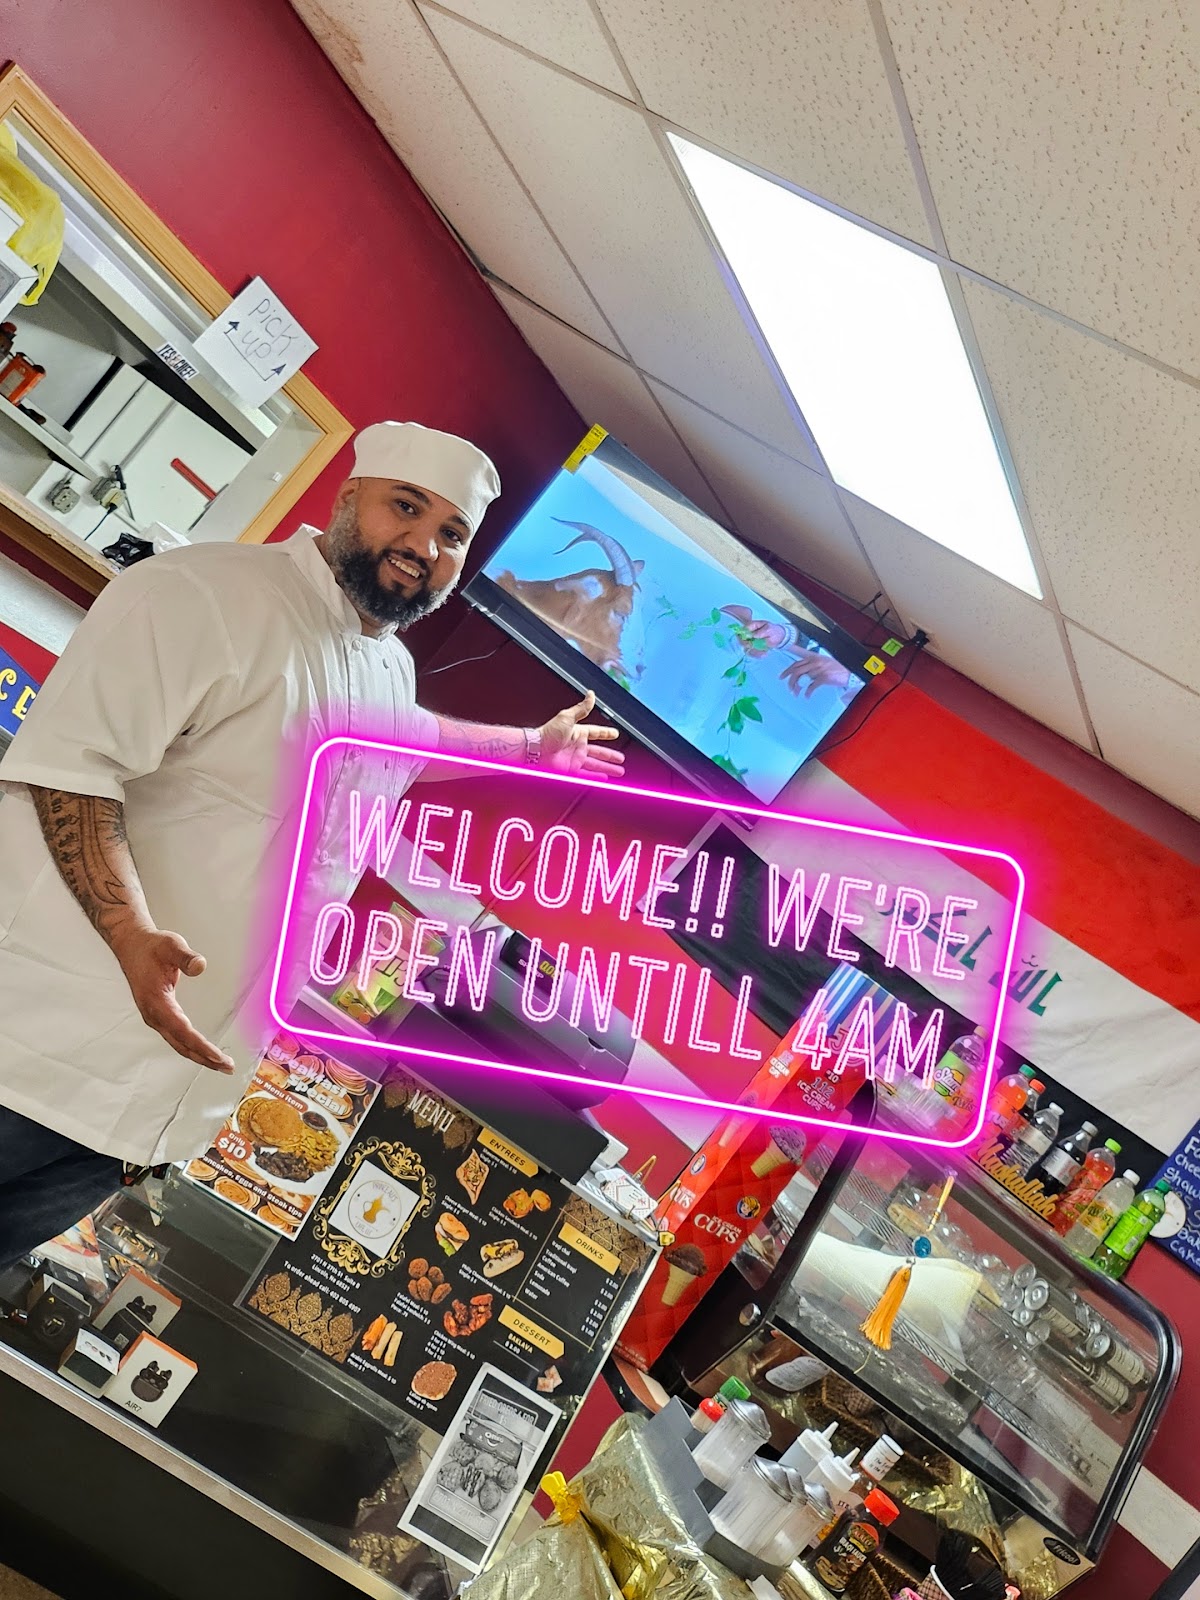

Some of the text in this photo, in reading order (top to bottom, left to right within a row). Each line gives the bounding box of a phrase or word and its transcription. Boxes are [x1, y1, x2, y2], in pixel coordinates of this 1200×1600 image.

[157, 343, 197, 381] YES CHEF!
[269, 1043, 348, 1100] Breakfast
[263, 1082, 303, 1109] Menu item
[285, 1072, 347, 1116] Special
[796, 1079, 836, 1112] ICE CREAM
[810, 1075, 836, 1099] 112
[406, 1088, 456, 1133] MENU
[801, 1093, 823, 1111] CUPS
[217, 1137, 246, 1158] $10
[227, 1132, 245, 1146] Only
[488, 1138, 526, 1166] ENTREES
[202, 1155, 302, 1217] ancakes, Eggs and Steak tips
[691, 1211, 740, 1245] CUPS
[711, 1215, 742, 1234] ICE CREAM
[575, 1237, 604, 1260] DRINKS
[290, 1266, 304, 1277] order
[304, 1274, 320, 1287] ahead
[508, 1333, 532, 1353] BAKLAVA
[512, 1318, 551, 1346] DESSERT
[124, 1399, 142, 1413] AIR7
[838, 1536, 854, 1551] IRAQI
[851, 1547, 867, 1562] SAUCE
[1053, 1543, 1078, 1564] Fricool
